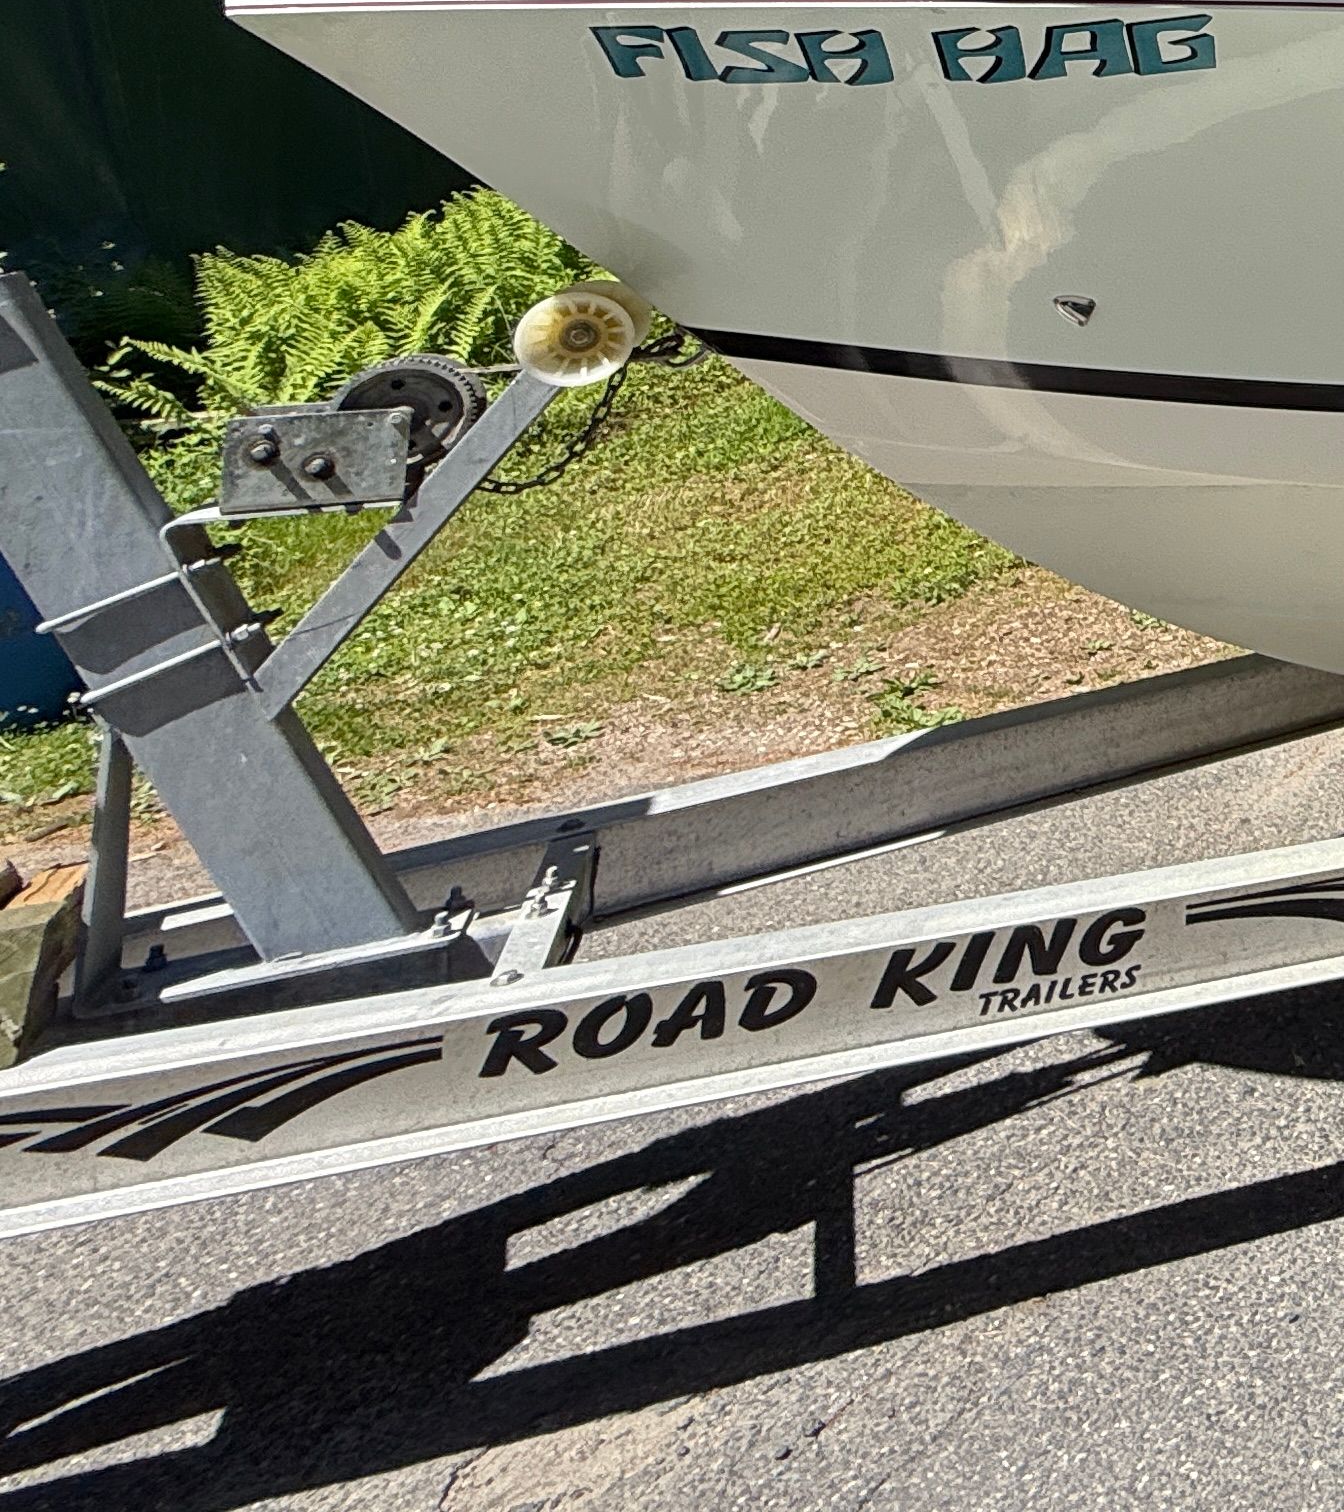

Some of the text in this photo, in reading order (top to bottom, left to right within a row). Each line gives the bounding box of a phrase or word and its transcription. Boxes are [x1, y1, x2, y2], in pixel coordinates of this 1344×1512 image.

[588, 14, 1217, 86] FISH HAG
[478, 907, 1146, 1078] ROAD KING
[978, 964, 1142, 1017] TRAILERS
